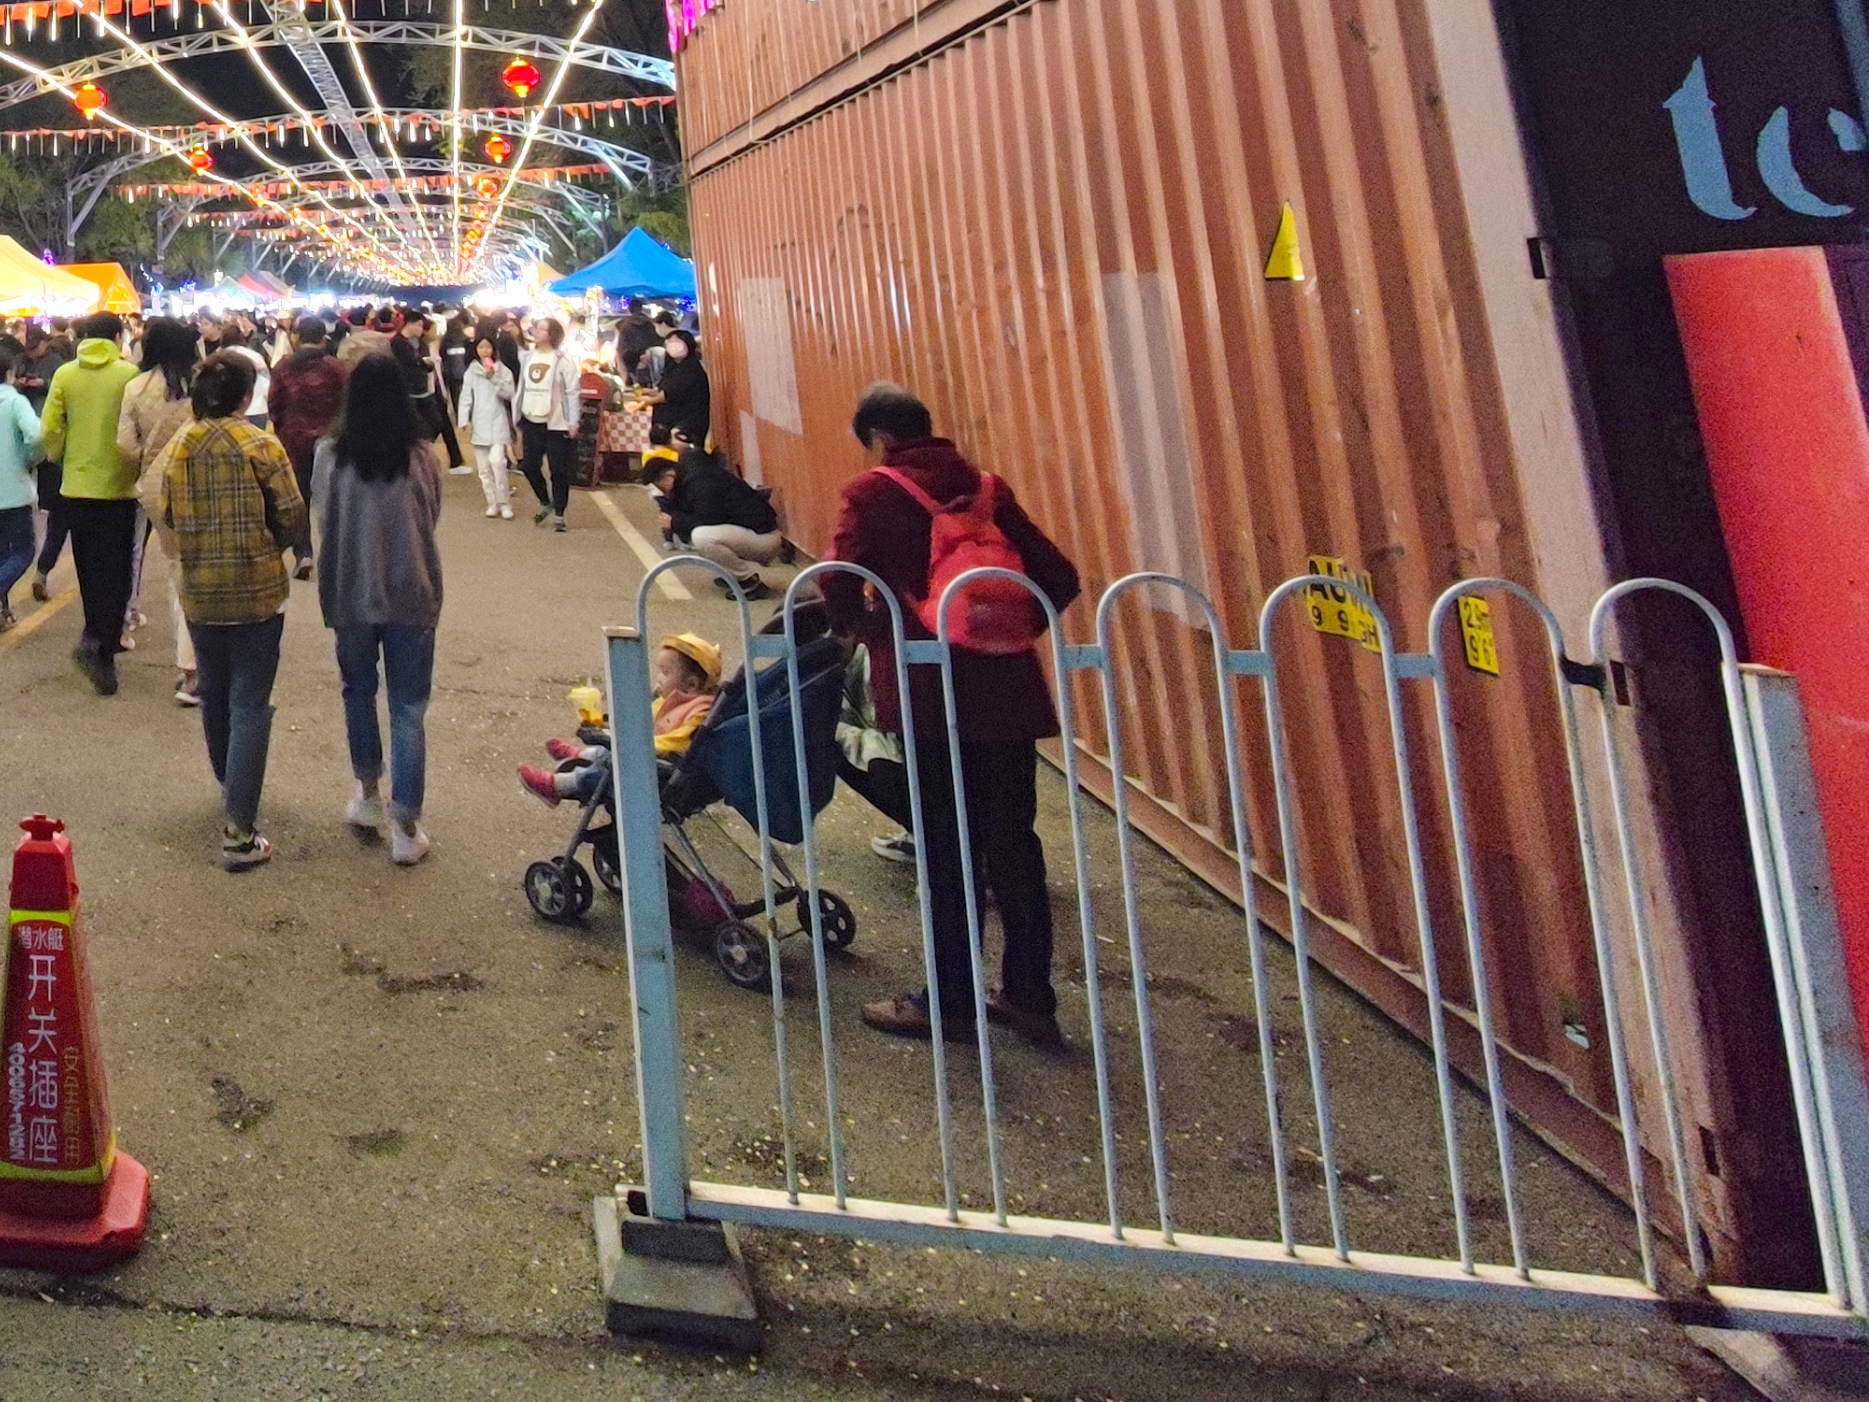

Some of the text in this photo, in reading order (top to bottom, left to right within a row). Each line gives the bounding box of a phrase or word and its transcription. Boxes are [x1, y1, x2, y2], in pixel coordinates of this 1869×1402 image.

[17, 925, 64, 951] 潜水艇
[27, 954, 59, 1165] 开关插座
